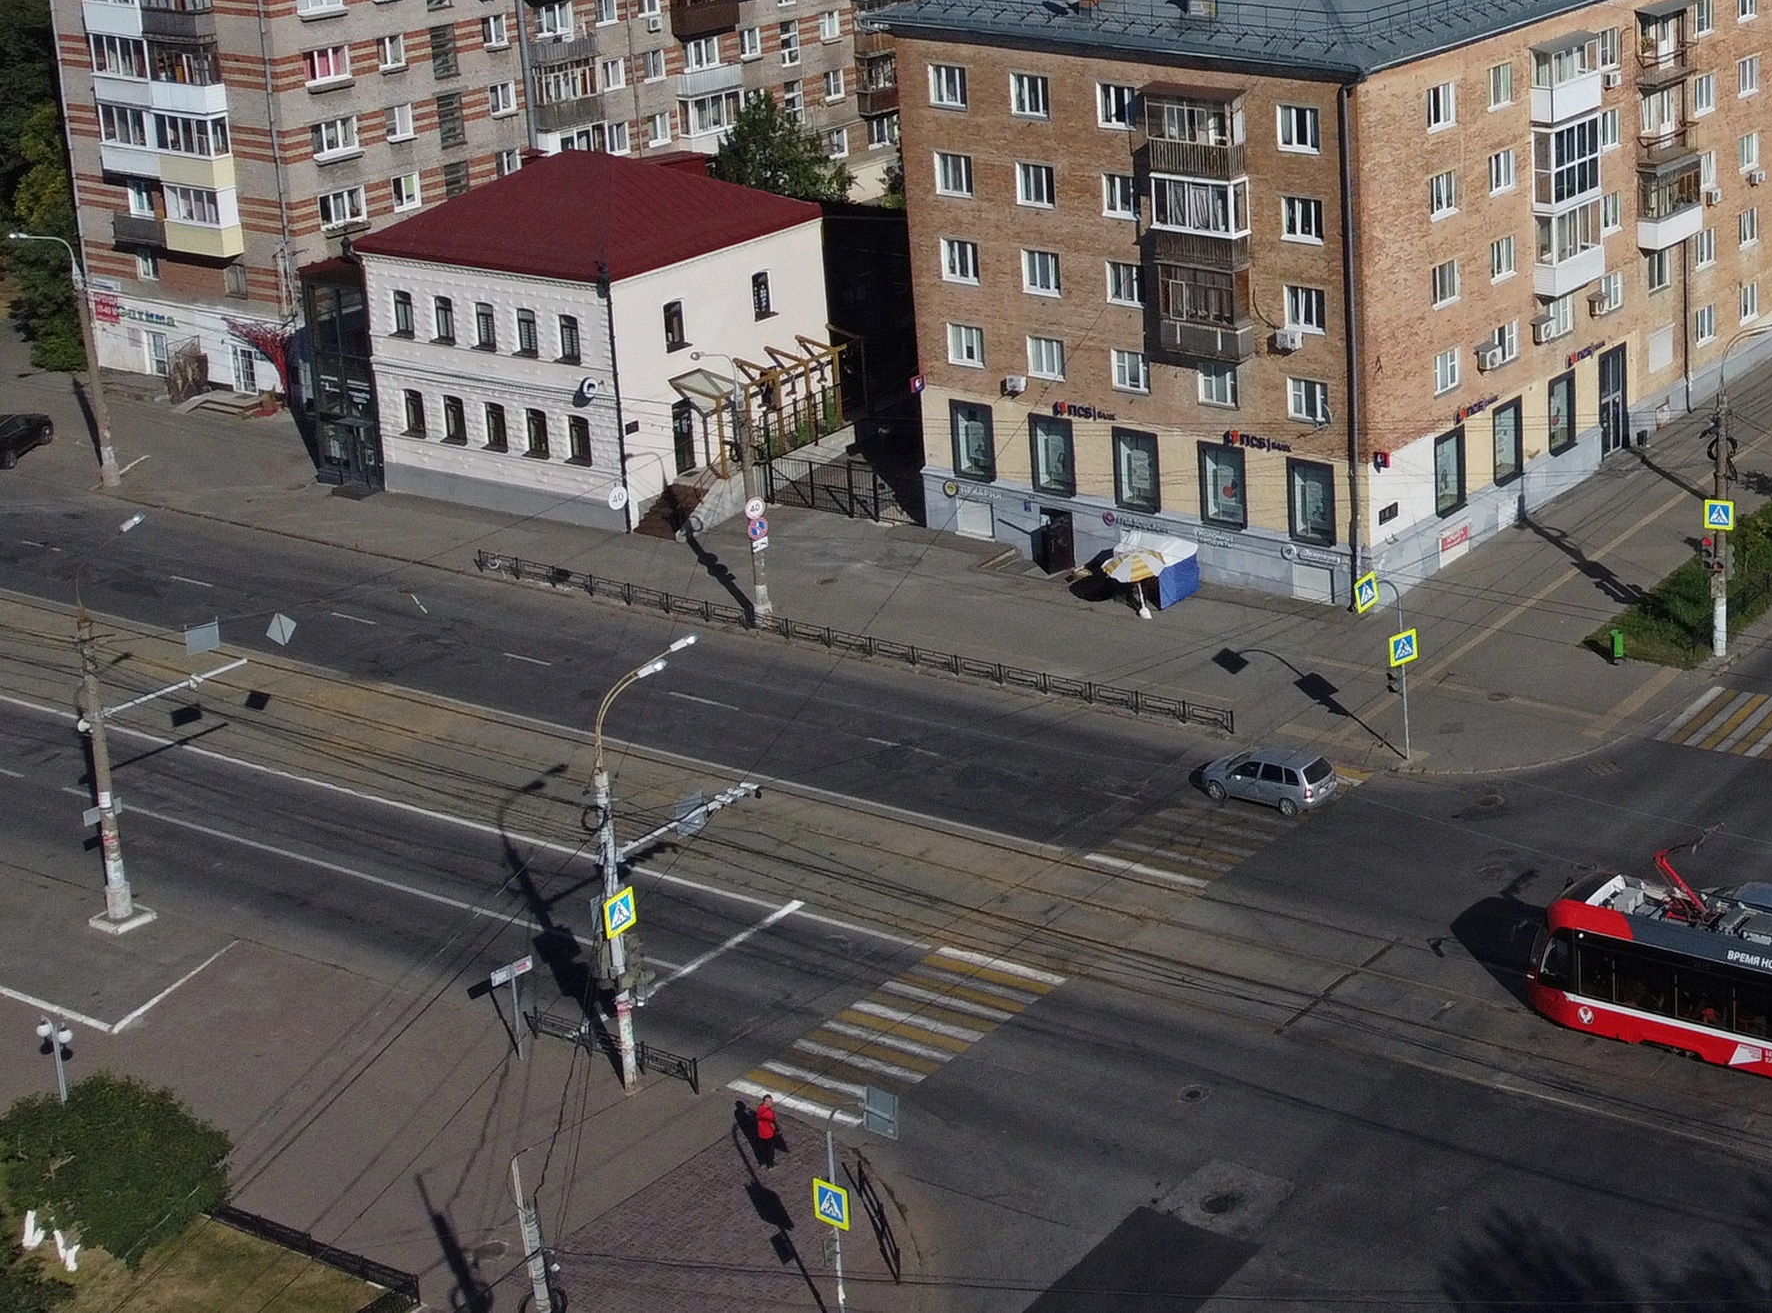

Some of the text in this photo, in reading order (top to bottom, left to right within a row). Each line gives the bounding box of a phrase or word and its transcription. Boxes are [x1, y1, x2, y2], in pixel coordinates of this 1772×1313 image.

[1067, 404, 1093, 420] ПСБ
[1239, 433, 1267, 450] ПСБ
[612, 491, 625, 504] 40
[749, 503, 761, 513] 40
[1727, 950, 1760, 965] ВРЕМЯ
